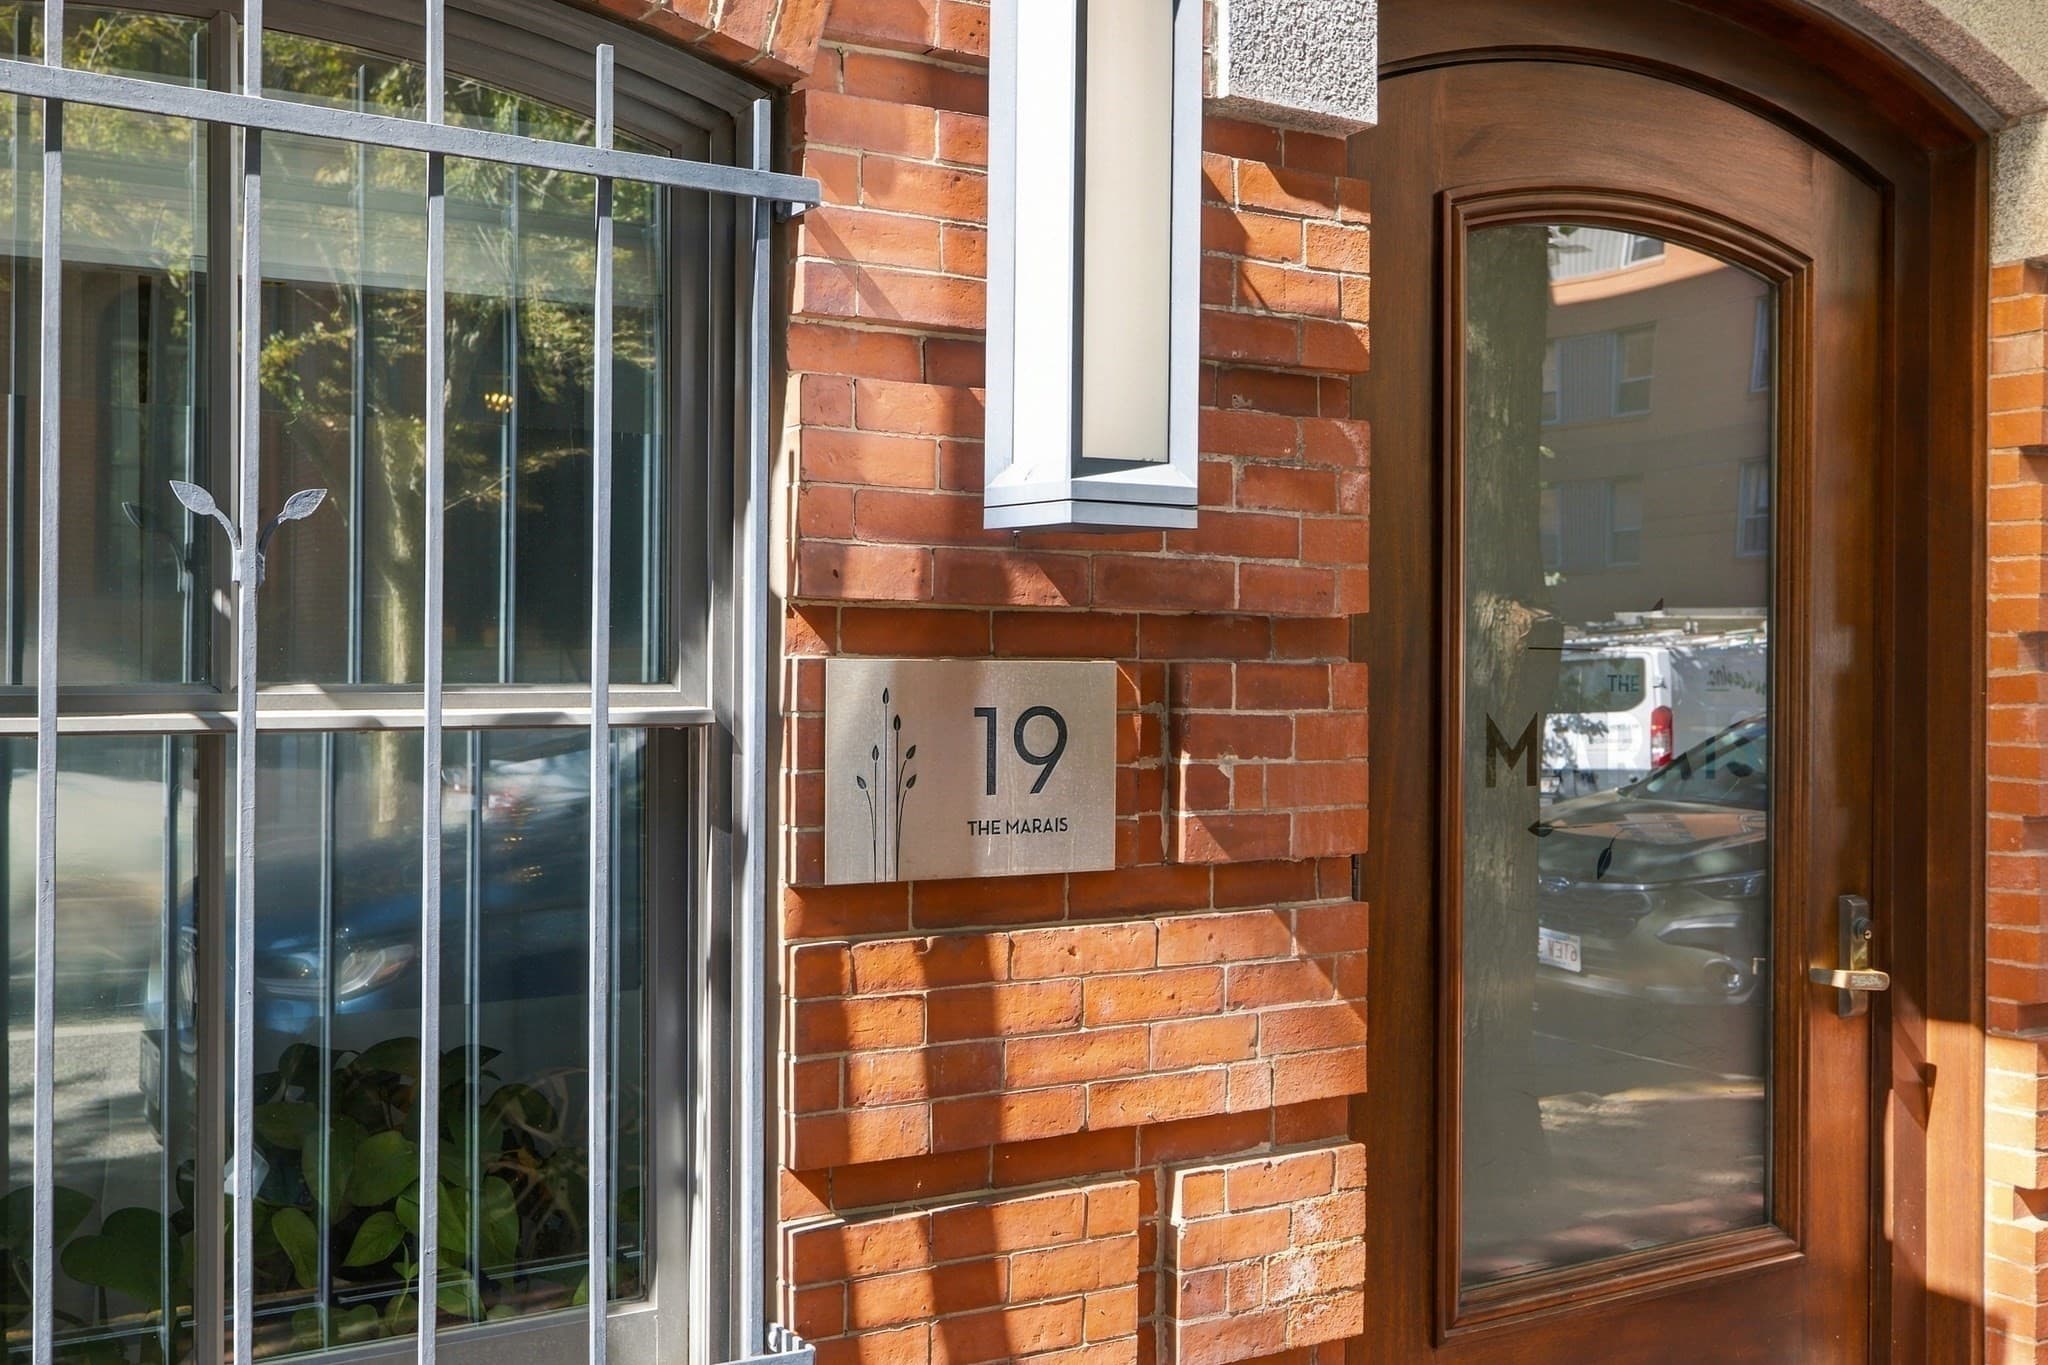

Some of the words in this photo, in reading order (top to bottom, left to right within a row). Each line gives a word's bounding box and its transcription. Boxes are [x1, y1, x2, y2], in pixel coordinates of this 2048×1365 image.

[1607, 674, 1639, 692] THE
[974, 705, 1067, 796] 19
[967, 820, 1002, 836] THE
[1006, 817, 1068, 834] MARAIS
